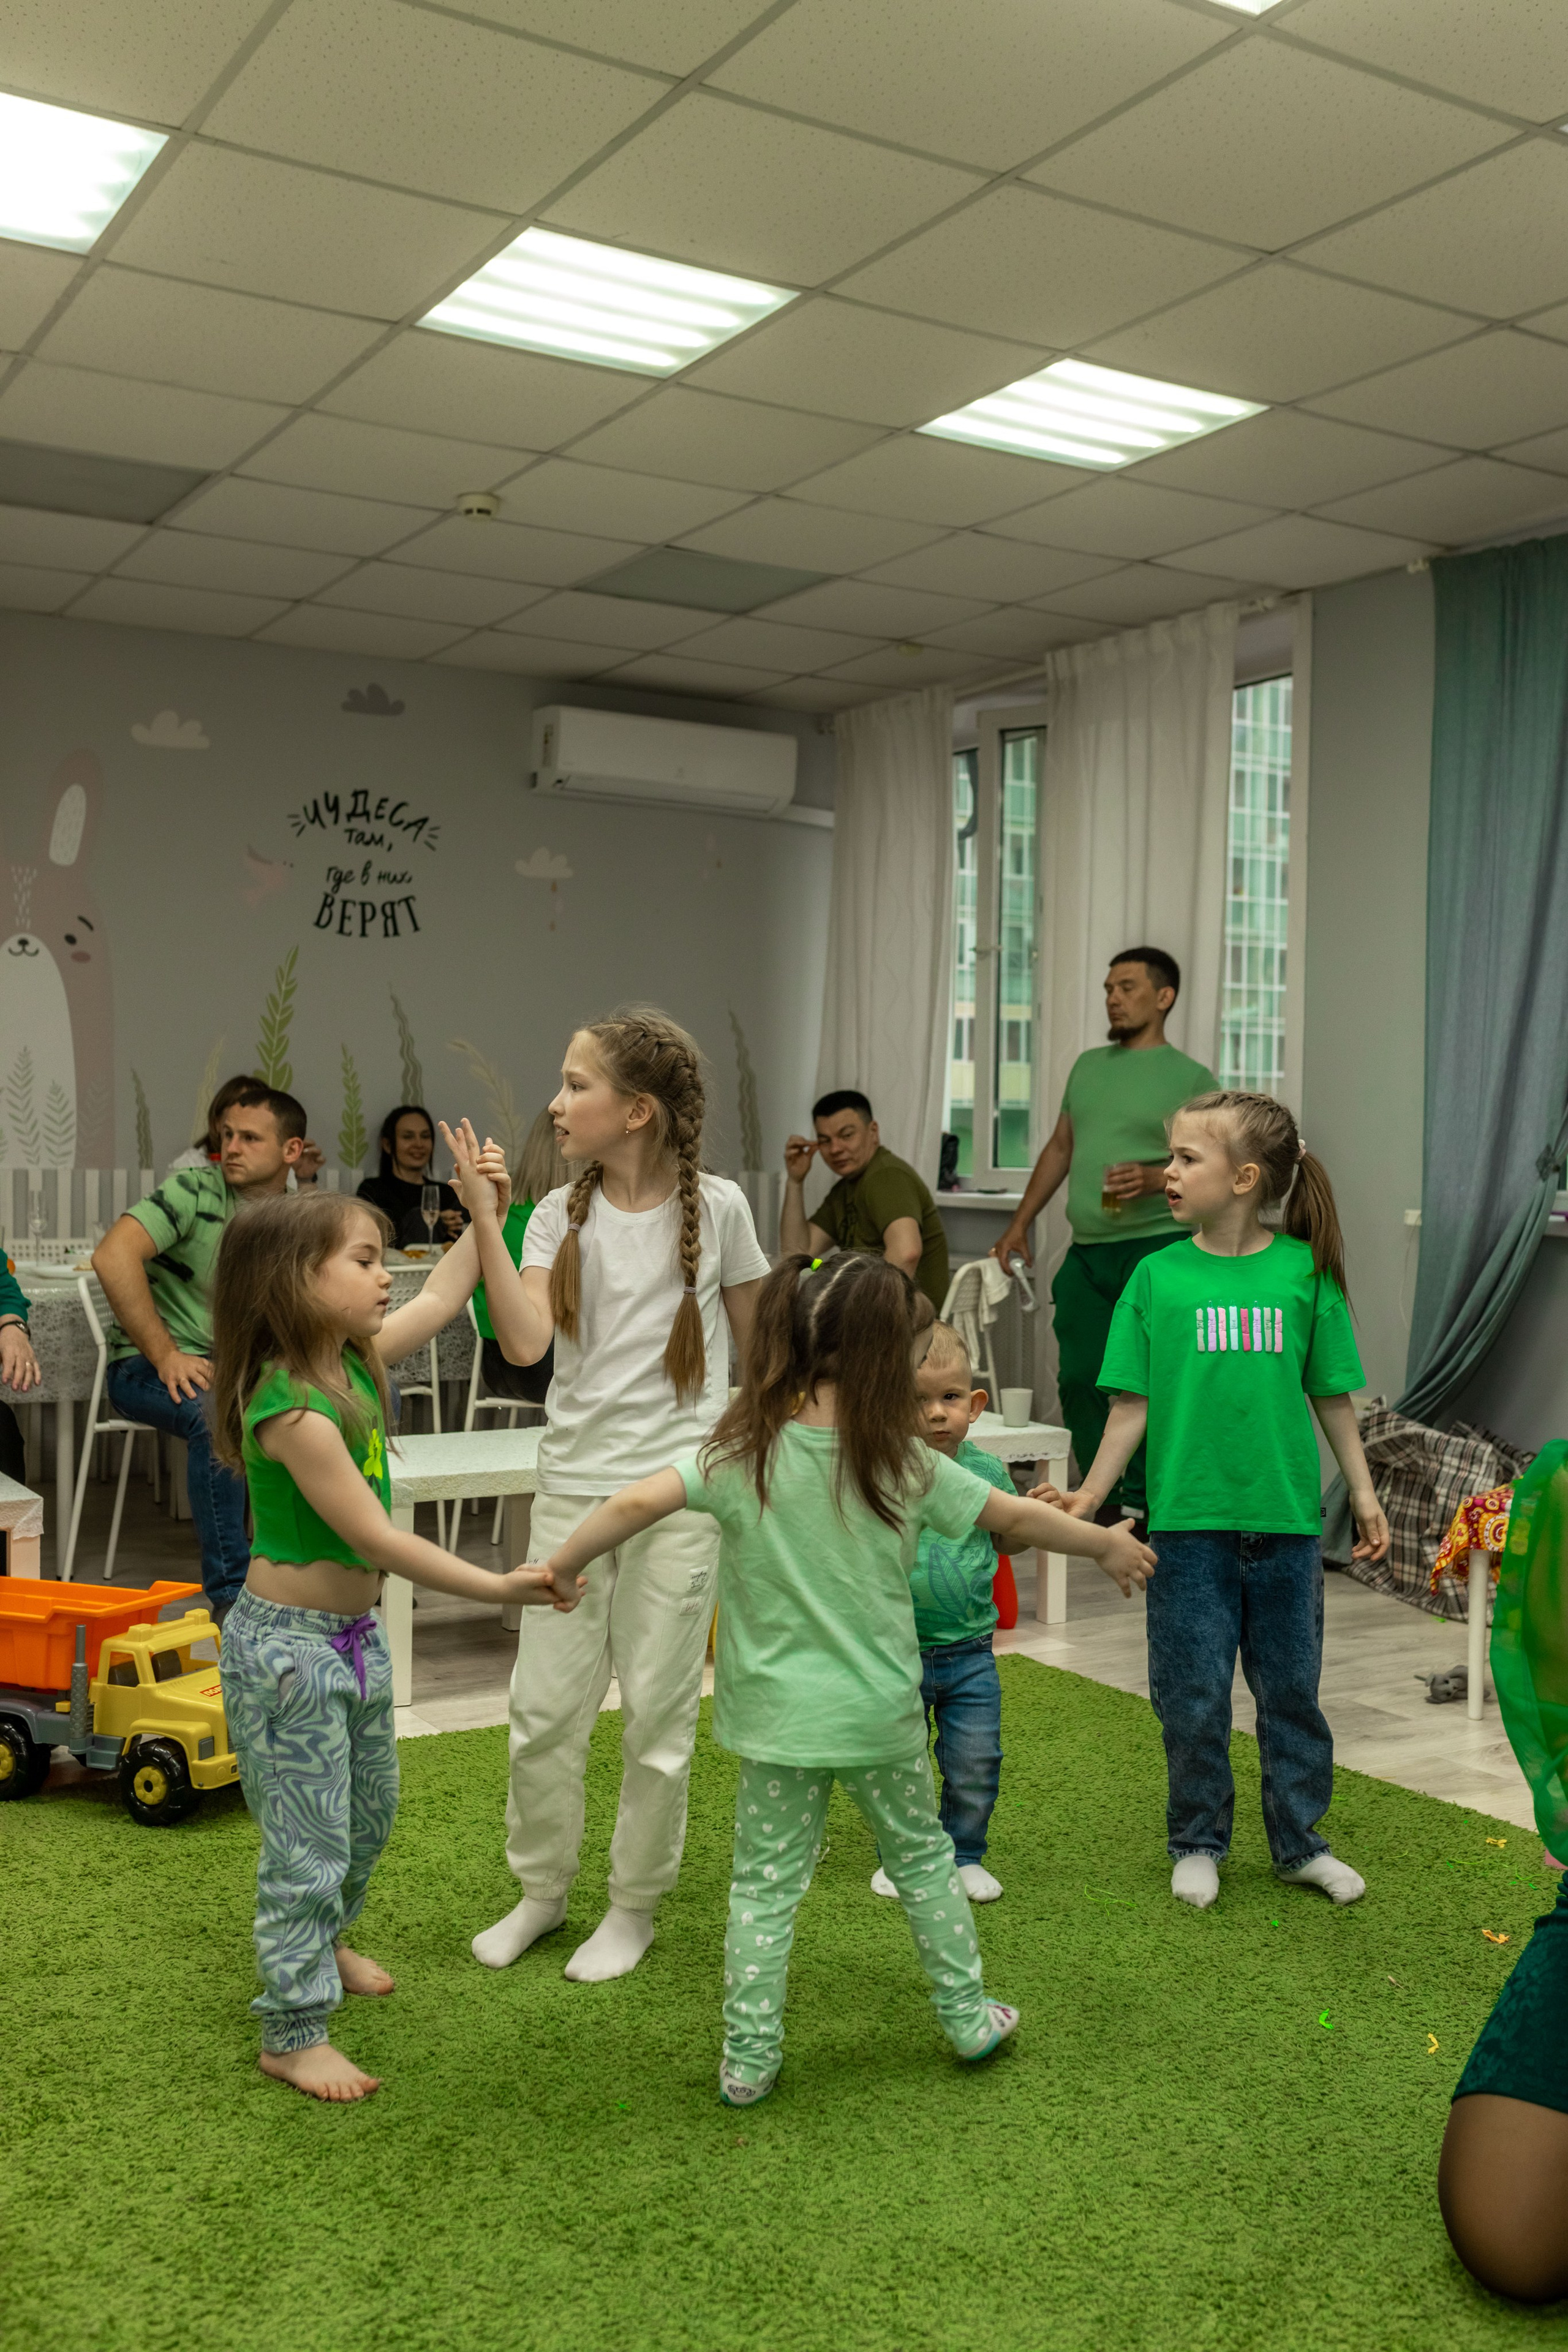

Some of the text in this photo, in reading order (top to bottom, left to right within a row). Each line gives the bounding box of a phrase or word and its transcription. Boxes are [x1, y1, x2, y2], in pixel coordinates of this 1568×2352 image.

[303, 788, 429, 843] ЧУДЕСА
[343, 827, 393, 853] там,
[325, 865, 355, 894] где
[360, 859, 372, 886] в
[313, 892, 421, 938] ВЕРЯТ
